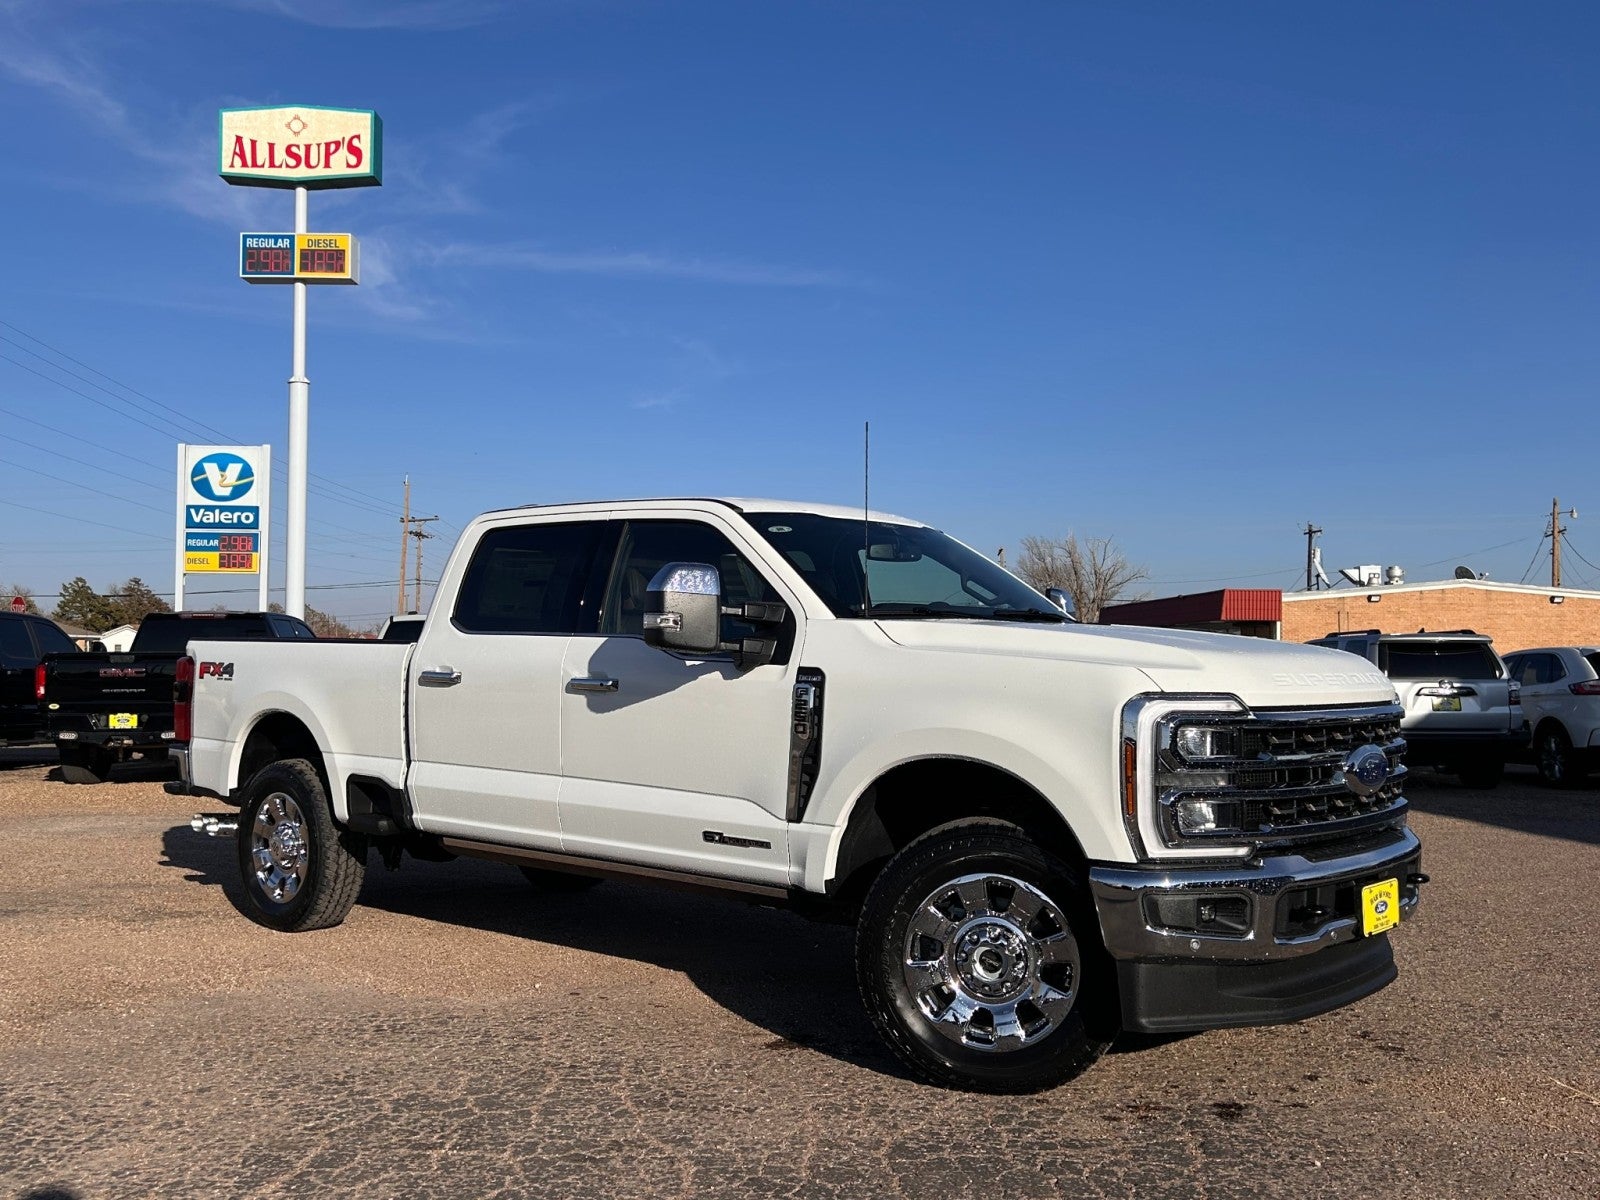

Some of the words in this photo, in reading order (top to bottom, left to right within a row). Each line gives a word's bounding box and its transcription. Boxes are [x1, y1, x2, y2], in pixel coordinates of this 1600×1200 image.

[229, 134, 363, 169] ALLSUP'S
[246, 238, 290, 248] REGULAR
[307, 239, 340, 248] DIESEL
[190, 508, 254, 524] Valero
[187, 539, 219, 547] REGULAR
[199, 662, 234, 679] FX4
